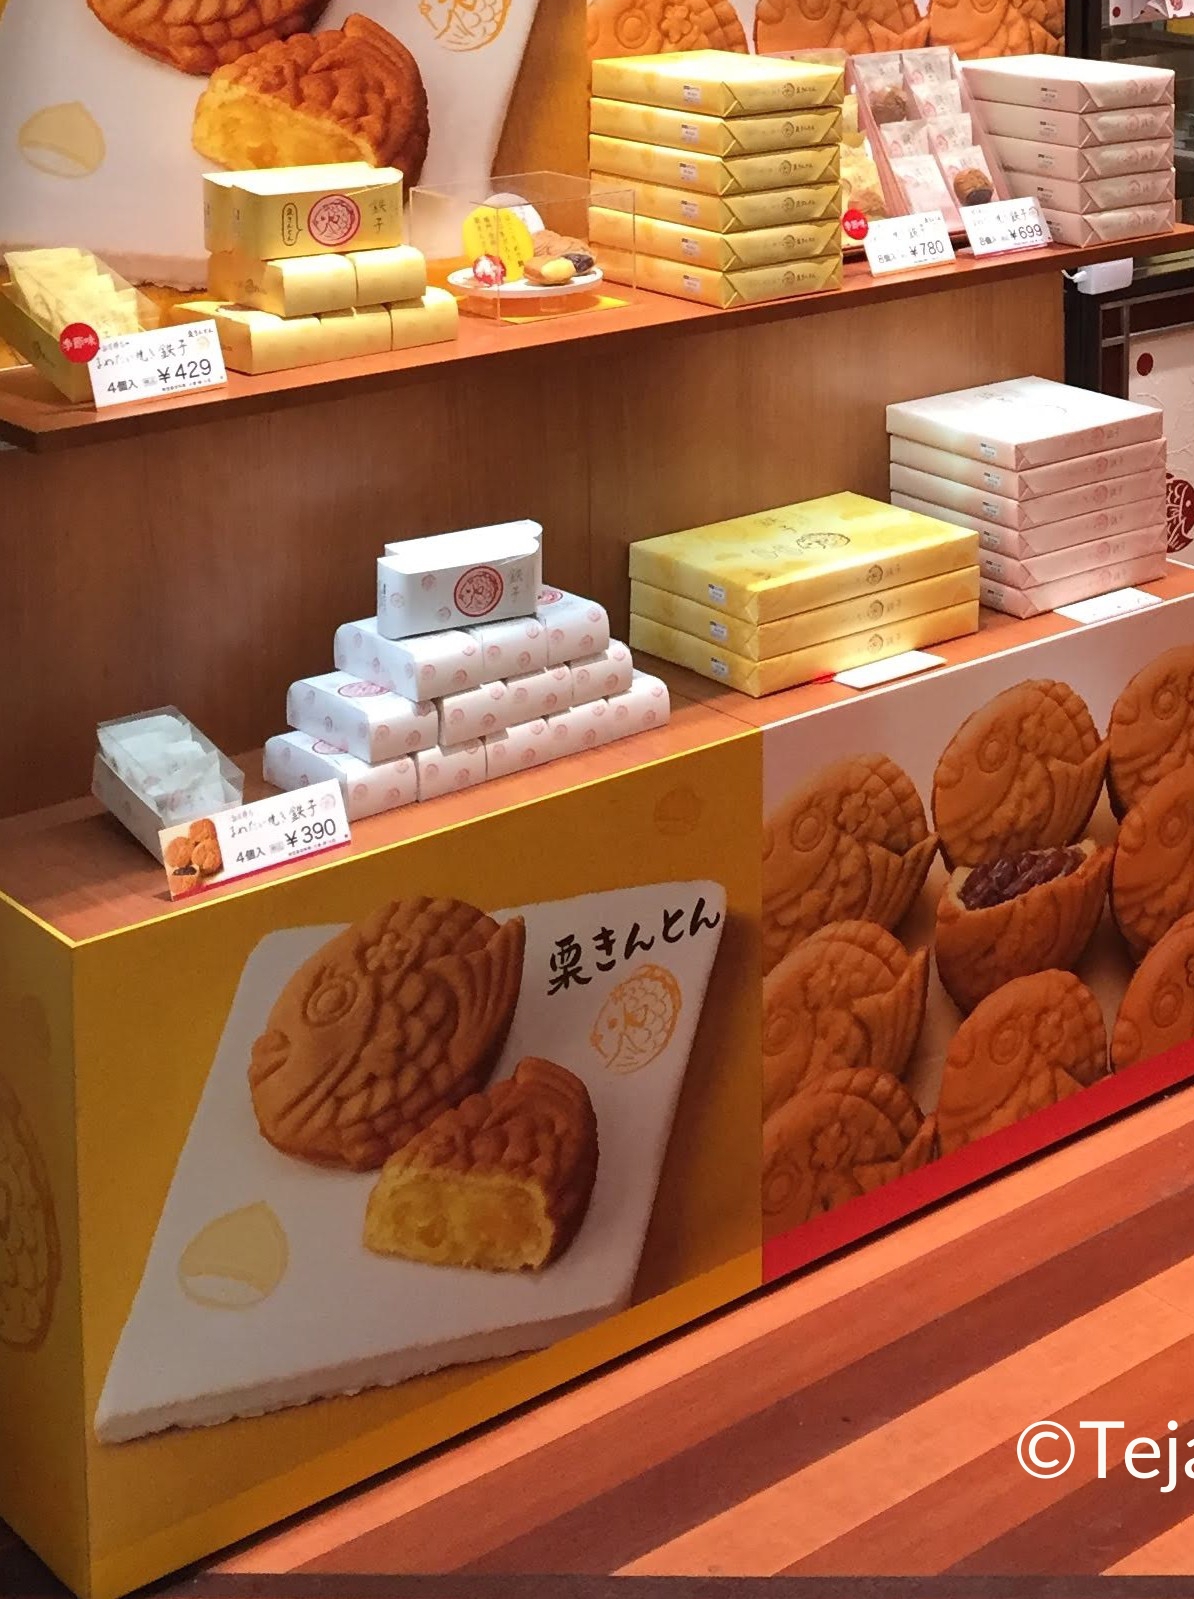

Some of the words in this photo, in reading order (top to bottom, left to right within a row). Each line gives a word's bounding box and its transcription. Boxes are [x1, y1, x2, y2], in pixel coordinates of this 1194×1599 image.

[106, 379, 139, 394] 4個入
[157, 358, 212, 384] ¥429
[236, 846, 267, 864] 4個入
[284, 818, 337, 848] ¥390
[547, 897, 721, 996] 栗きんとん
